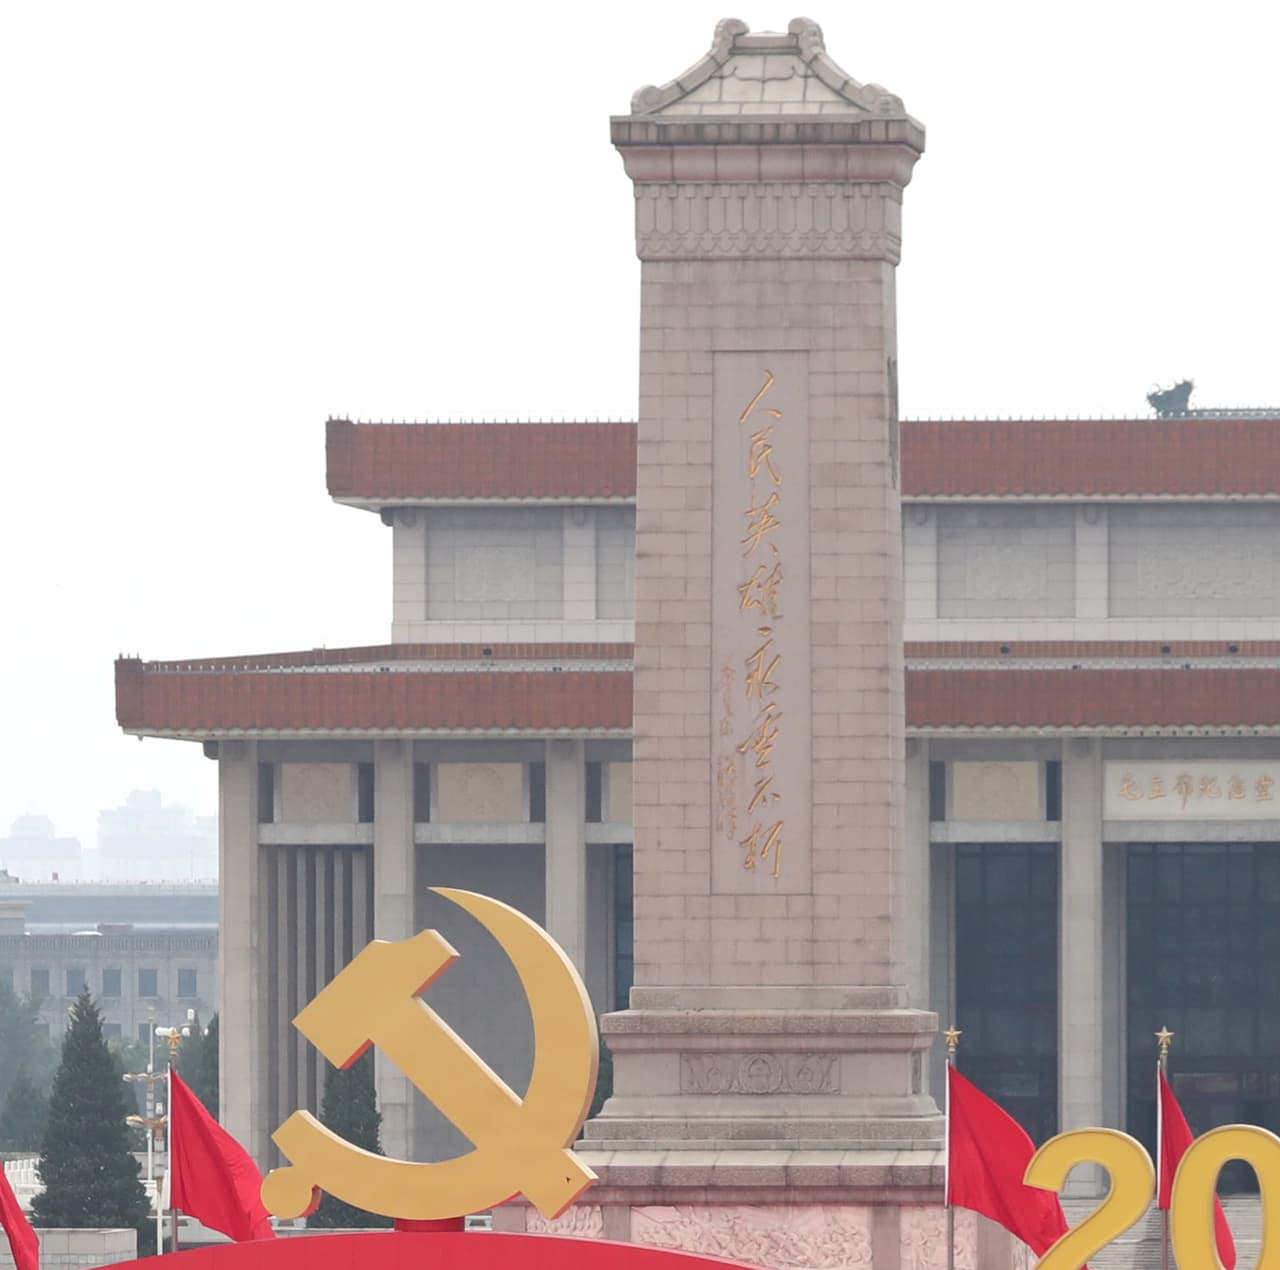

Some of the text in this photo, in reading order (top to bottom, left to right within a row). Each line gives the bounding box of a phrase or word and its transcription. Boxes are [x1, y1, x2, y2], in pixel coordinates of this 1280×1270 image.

[738, 369, 785, 879] 人民英雄永垂不朽
